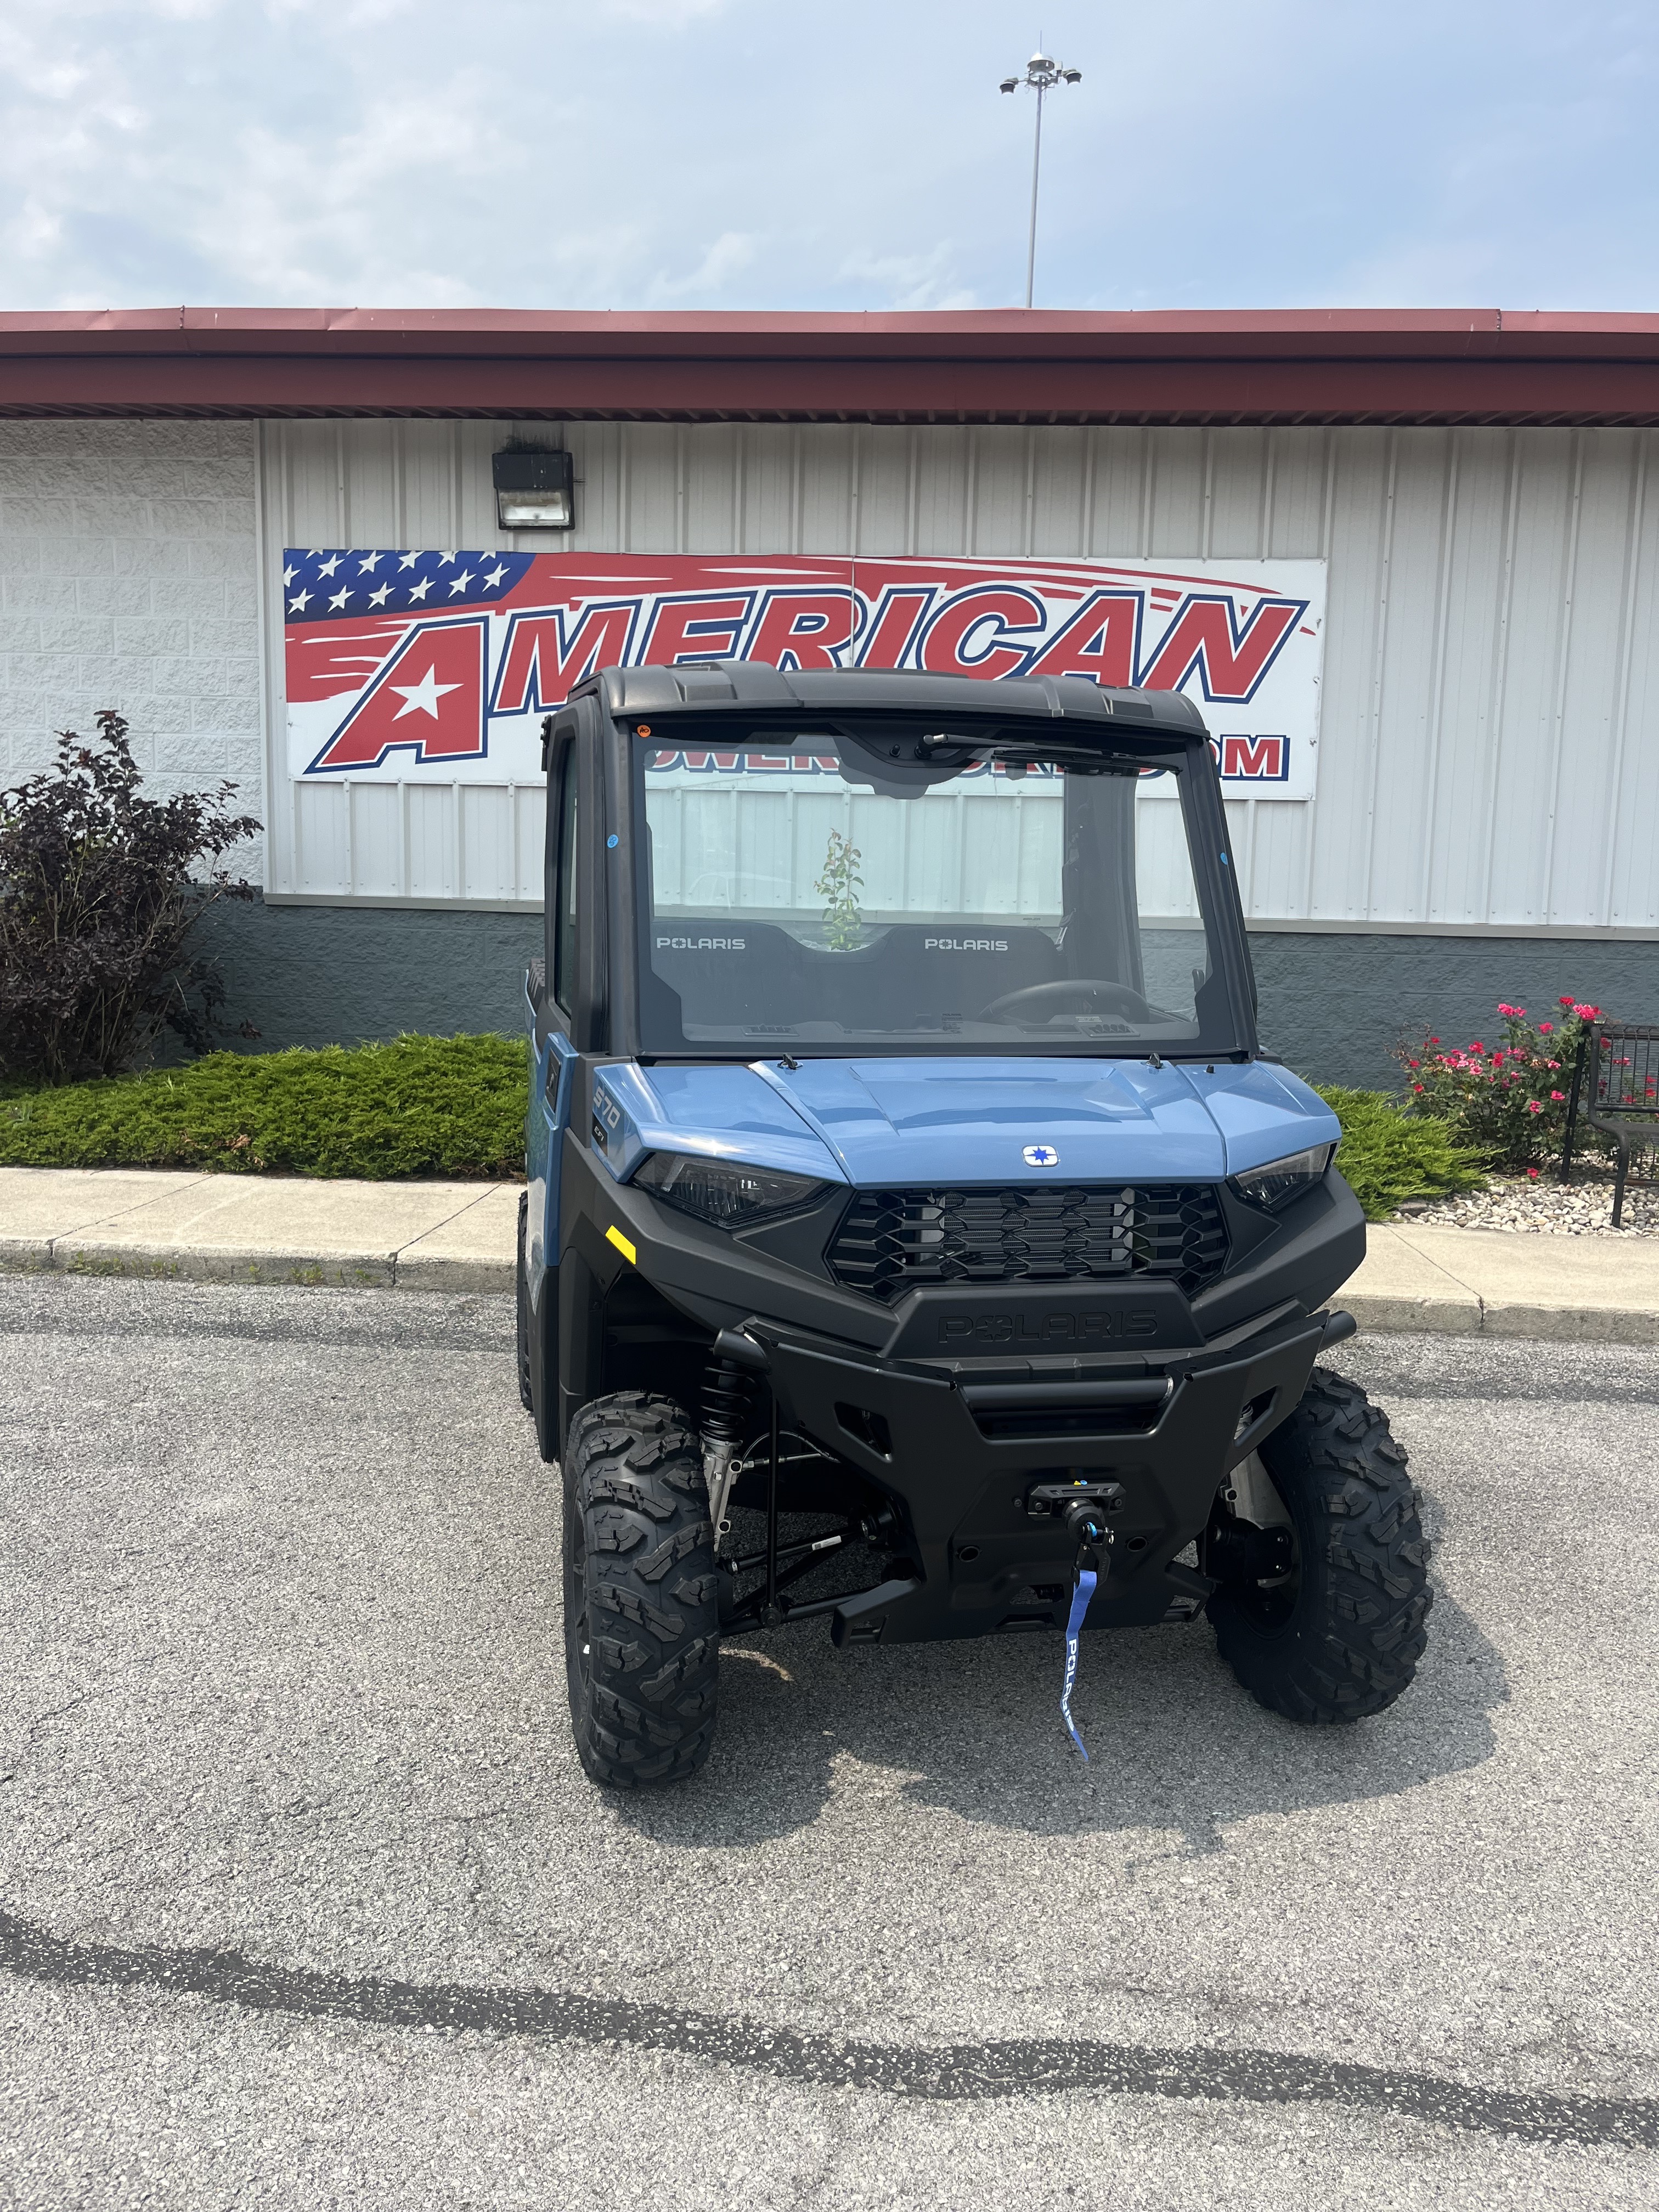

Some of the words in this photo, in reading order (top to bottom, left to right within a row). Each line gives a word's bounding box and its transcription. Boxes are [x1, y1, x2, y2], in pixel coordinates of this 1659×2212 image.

[302, 584, 1311, 775] AMERICAN
[656, 938, 746, 950] POLARIS
[925, 939, 1008, 951] POLARIS
[593, 1086, 620, 1129] 570
[594, 1126, 604, 1141] EFI
[938, 1309, 1158, 1344] POLARIS
